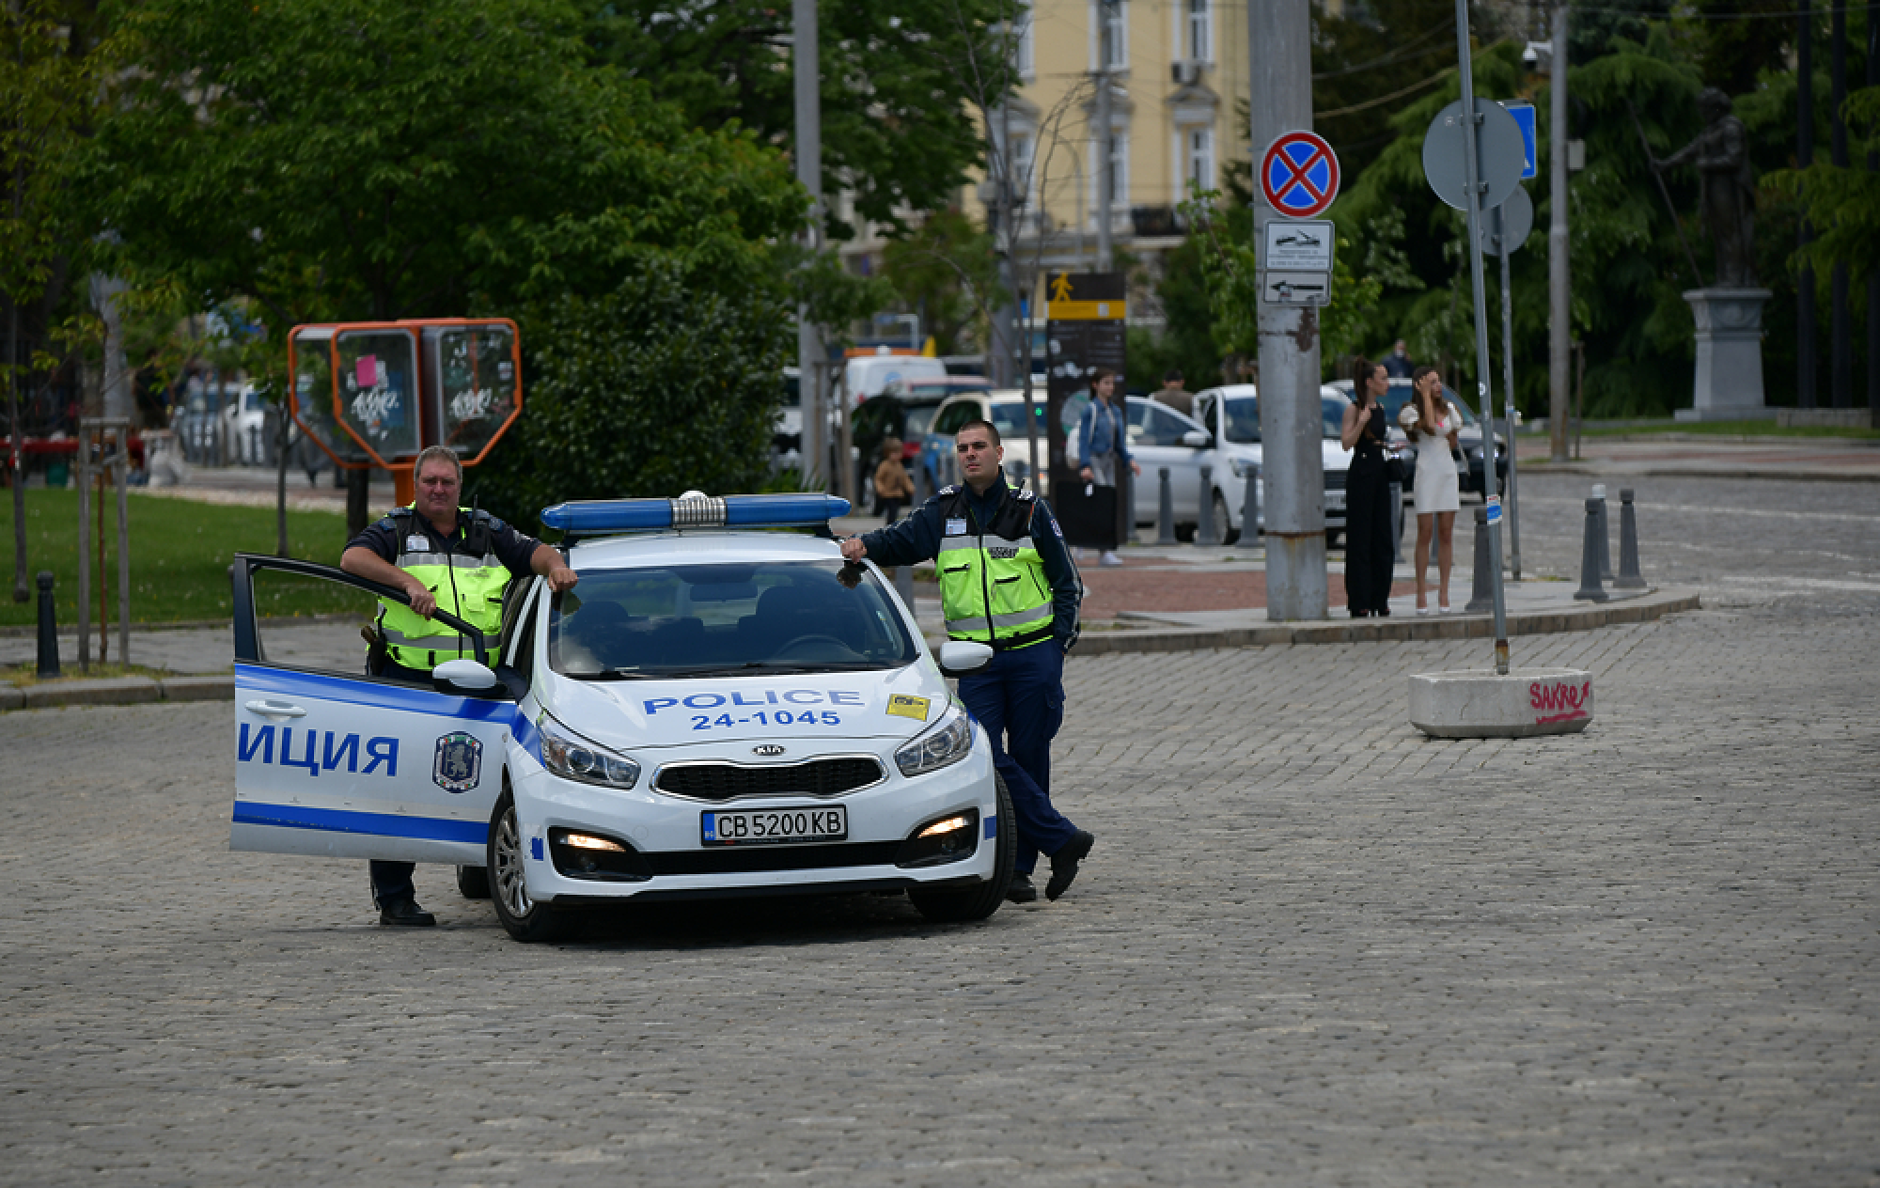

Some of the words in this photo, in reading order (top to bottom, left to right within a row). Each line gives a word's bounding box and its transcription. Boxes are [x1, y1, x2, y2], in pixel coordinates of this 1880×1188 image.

[643, 689, 865, 715] POLICE
[690, 709, 841, 730] 24-1045
[238, 722, 399, 777] ИЦИЯ
[718, 815, 748, 837] CB
[752, 813, 807, 836] 5200
[811, 811, 841, 834] KB
